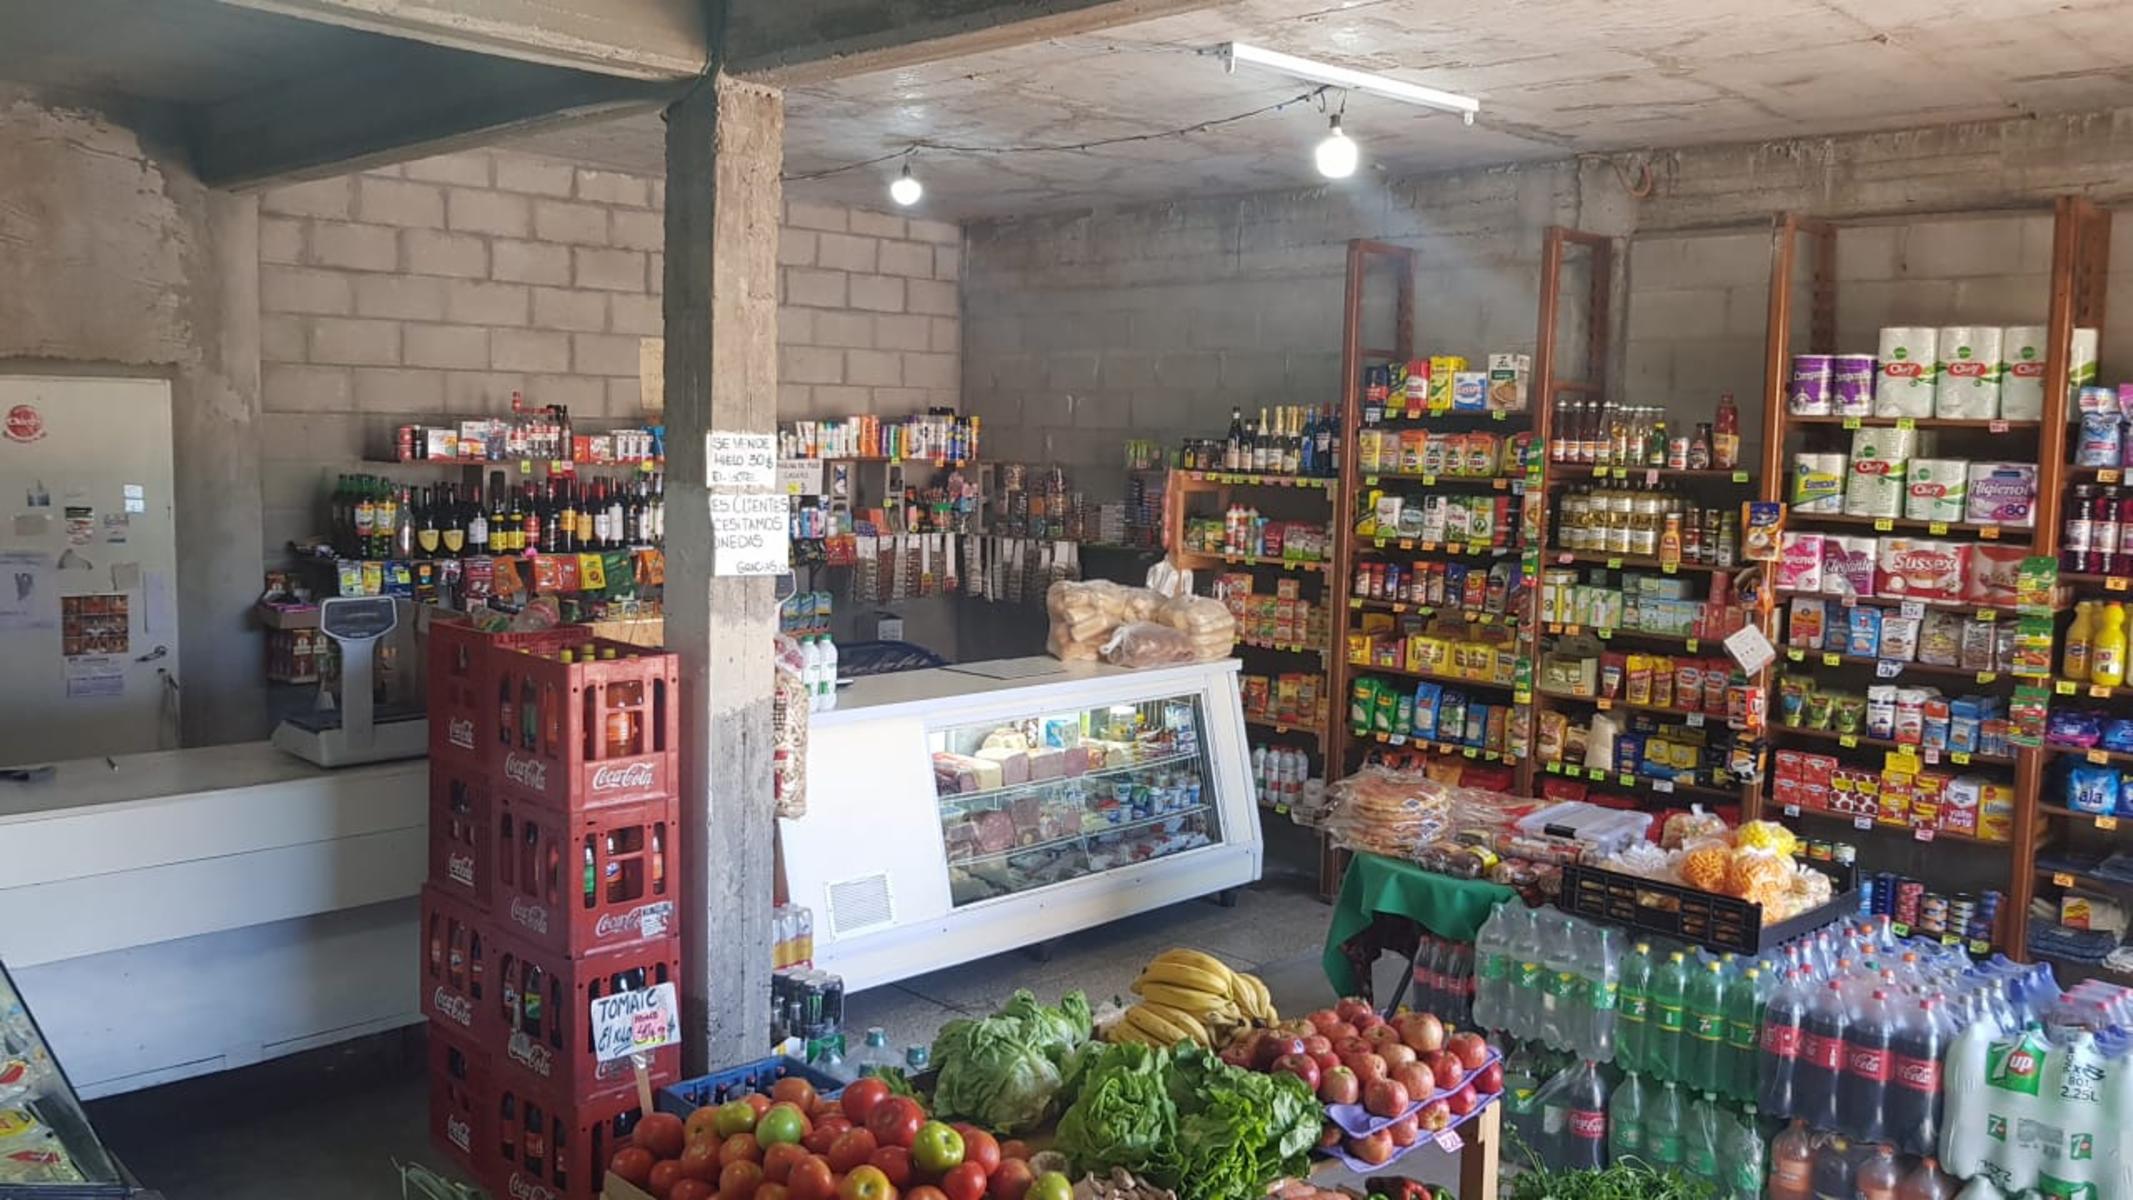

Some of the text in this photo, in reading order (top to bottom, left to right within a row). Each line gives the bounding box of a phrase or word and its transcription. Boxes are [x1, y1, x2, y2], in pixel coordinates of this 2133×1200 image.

[712, 437, 730, 450] SE
[714, 453, 744, 466] HIELO
[1970, 478, 2031, 498] Higienol
[733, 497, 789, 513] CLIENTES
[2006, 504, 2027, 516] 80
[1893, 551, 1957, 572] Sussex
[505, 751, 546, 790] Coca-Cola
[592, 762, 654, 790] Coca-Cola
[435, 985, 471, 1026] Coca-Cola
